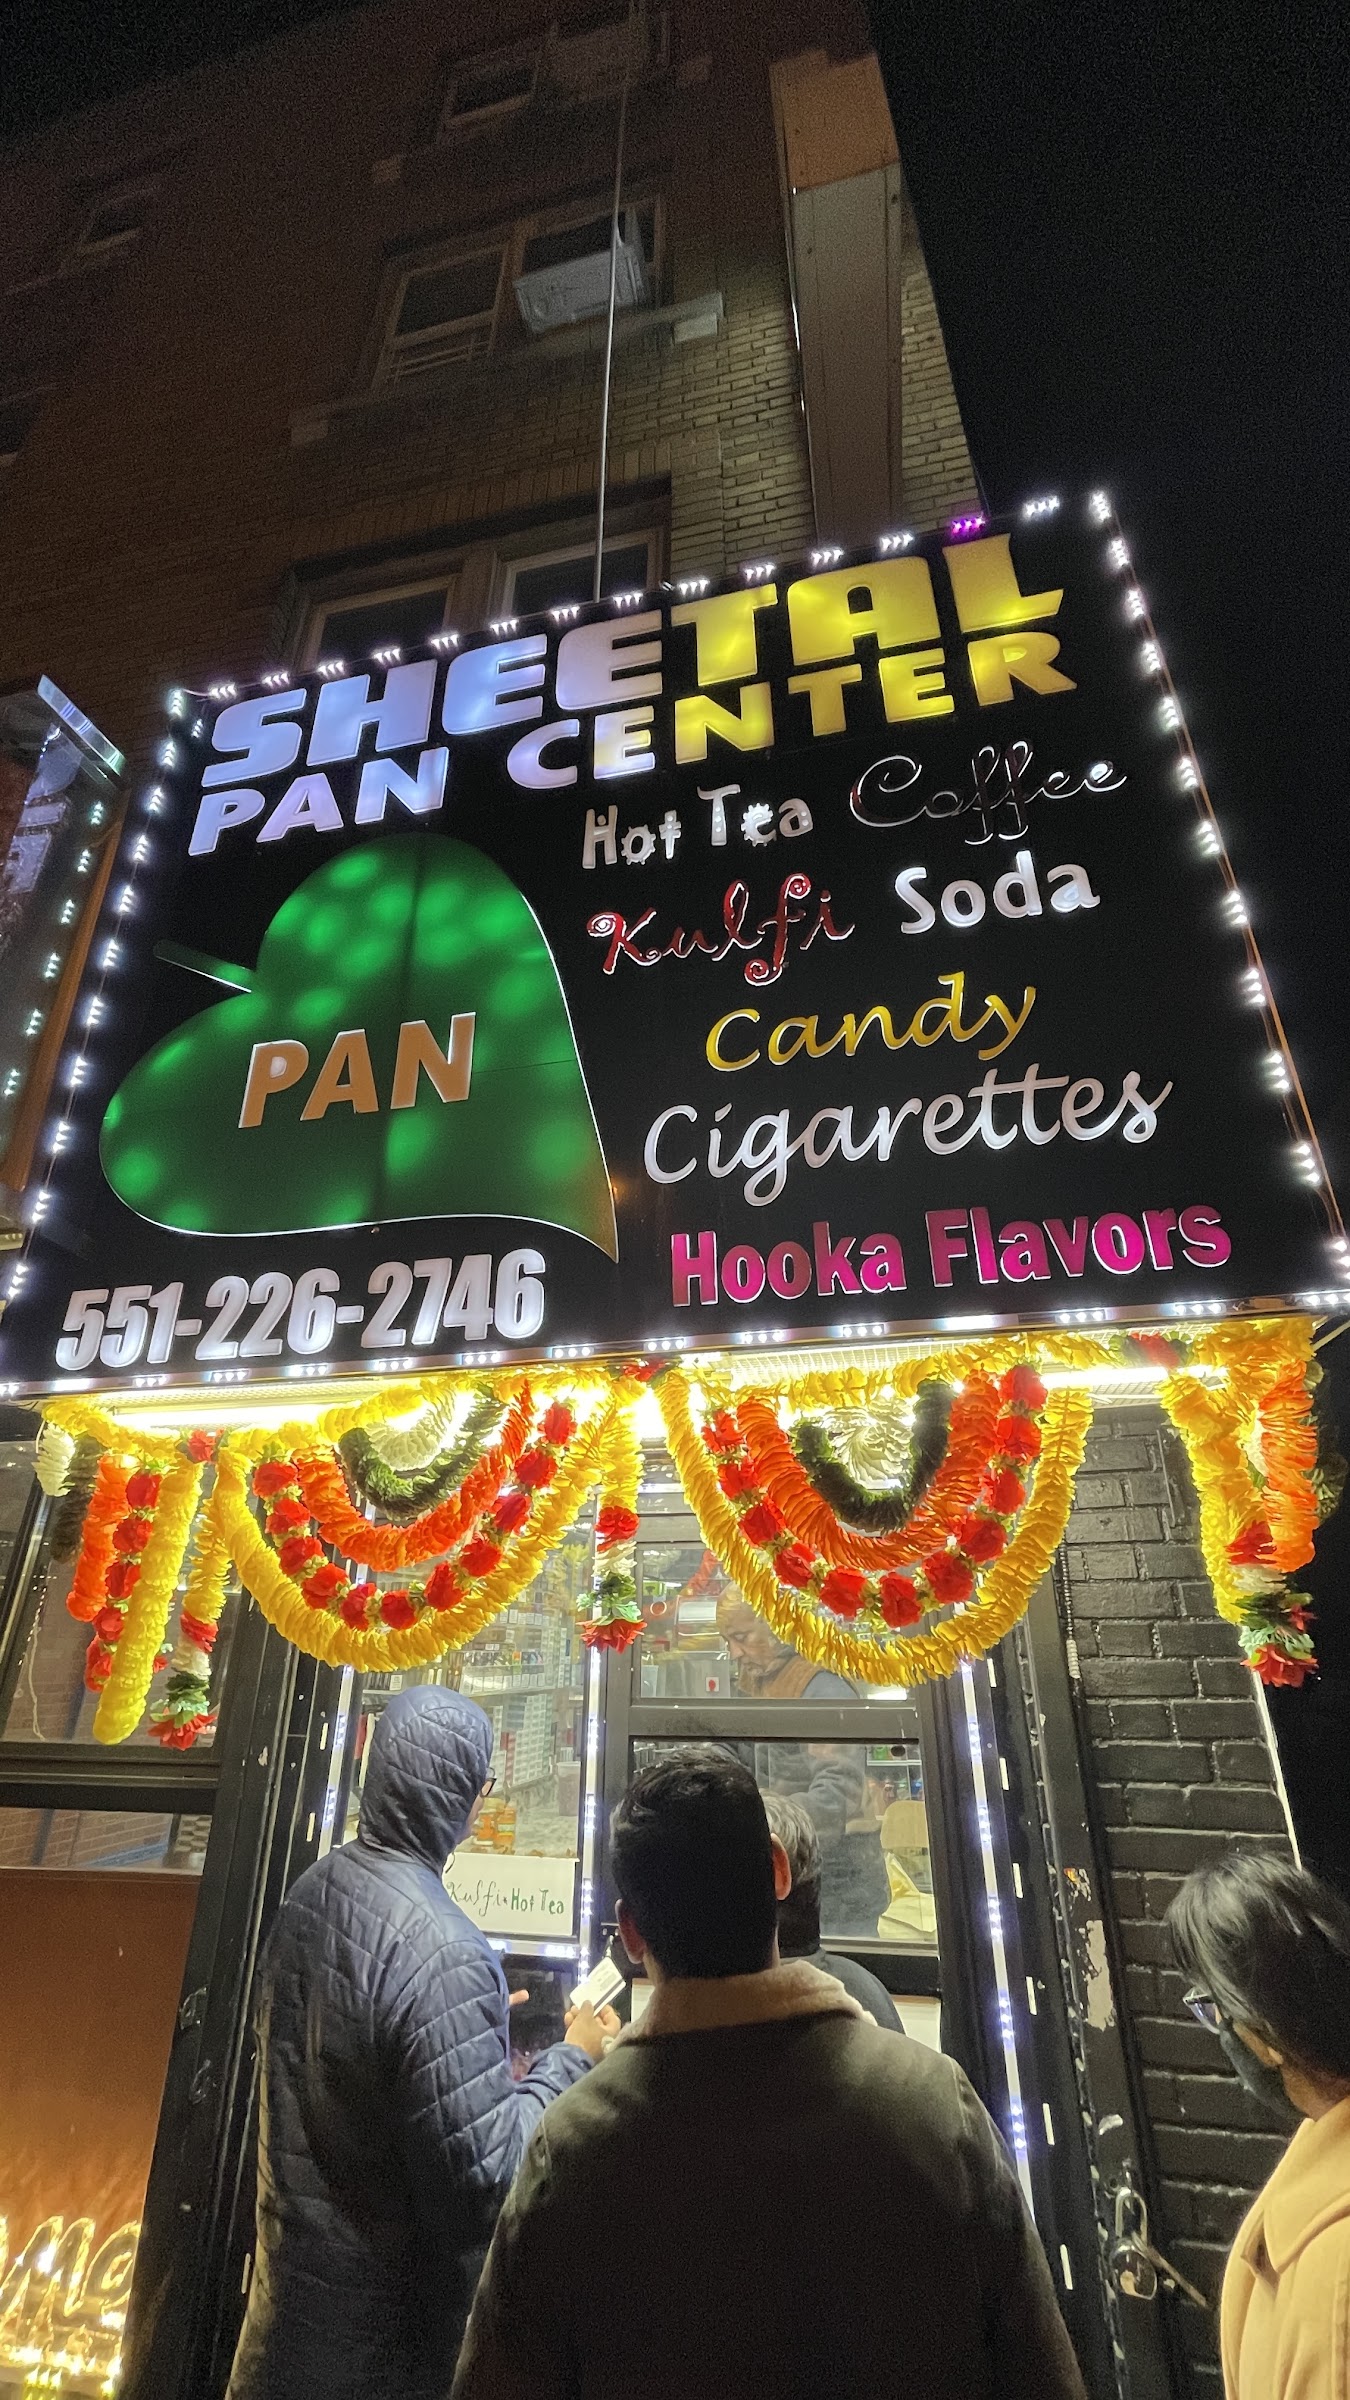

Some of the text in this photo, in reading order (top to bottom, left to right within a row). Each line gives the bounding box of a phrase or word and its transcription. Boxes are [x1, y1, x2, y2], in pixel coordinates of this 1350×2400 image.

[200, 533, 1064, 787] SHEETAL
[187, 631, 1077, 856] PAN CENTER
[849, 740, 1128, 845] Coffee
[581, 784, 814, 869] Hot Tea
[587, 873, 856, 987] Kulfi
[894, 850, 1101, 934] Soda
[238, 1011, 477, 1129] PAN
[706, 970, 1036, 1071] Candy
[643, 1063, 1173, 1206] Cigarettes
[55, 1247, 547, 1372] 551-226-2746
[671, 1203, 1232, 1307] Hooka Flavors
[511, 1887, 535, 1912] Hot
[539, 1887, 565, 1915] Tea
